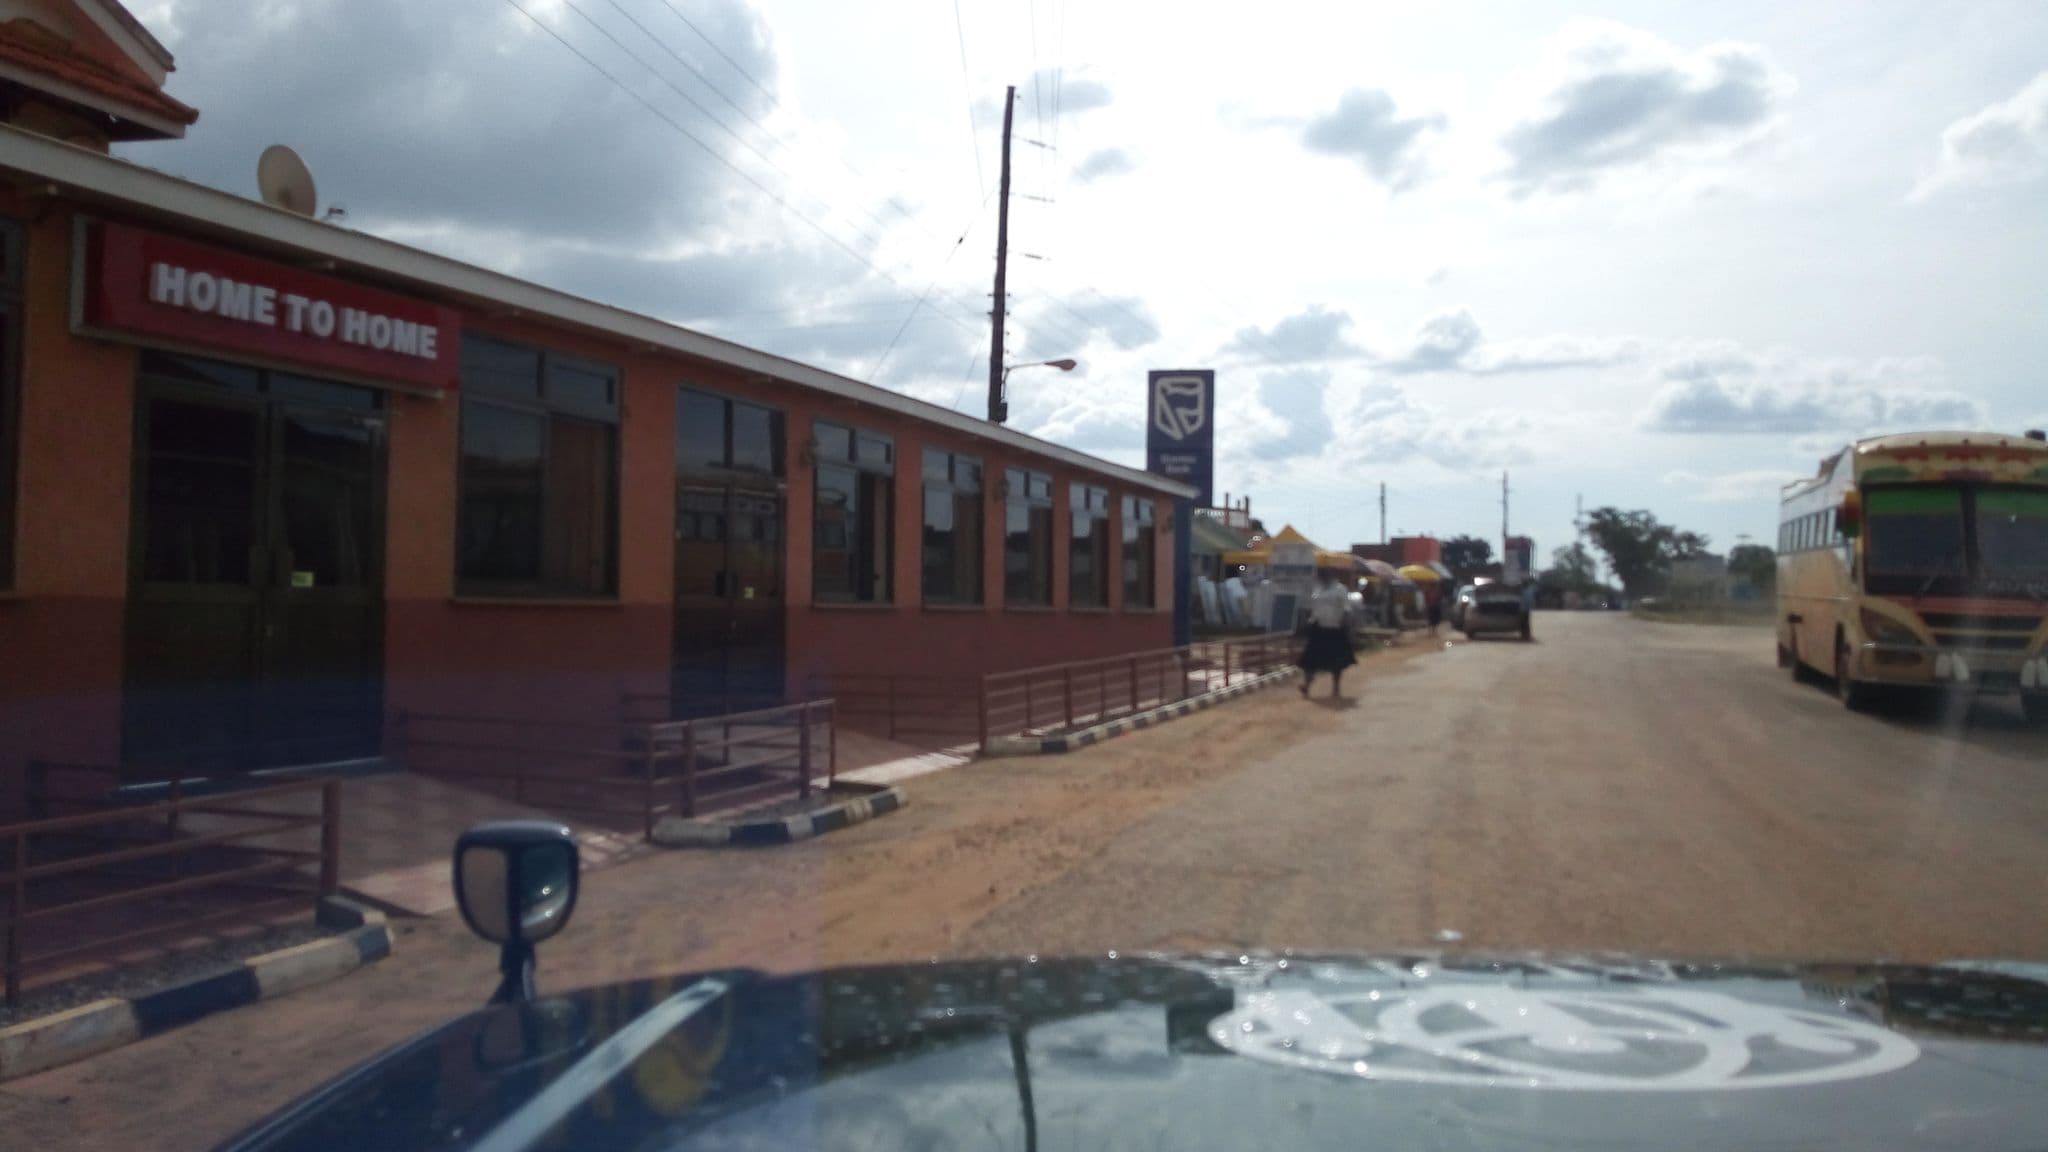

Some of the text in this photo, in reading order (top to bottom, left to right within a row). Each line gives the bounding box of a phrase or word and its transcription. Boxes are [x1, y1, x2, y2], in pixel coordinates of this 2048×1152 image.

[150, 262, 438, 360] HOME TO HOME
